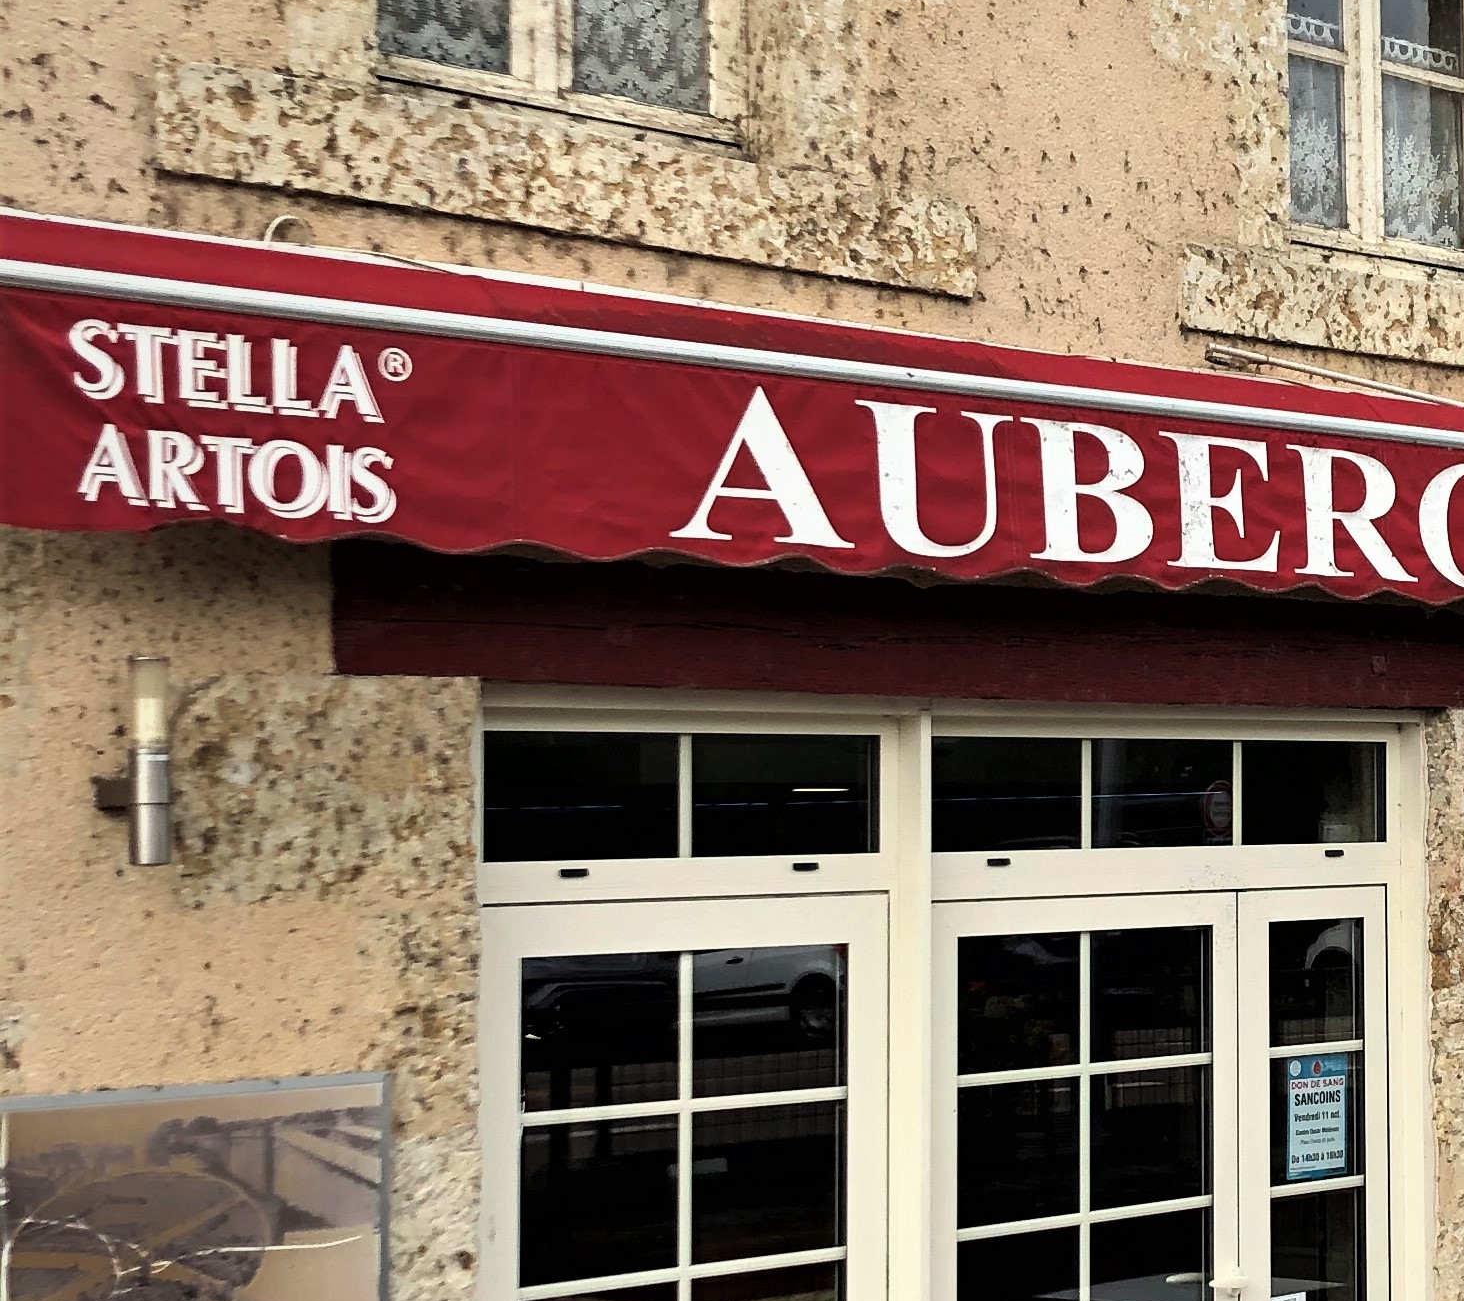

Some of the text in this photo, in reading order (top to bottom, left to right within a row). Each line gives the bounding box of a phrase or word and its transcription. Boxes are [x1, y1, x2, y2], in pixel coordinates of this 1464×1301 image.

[77, 423, 397, 524] ARTOIS
[1291, 1077, 1344, 1090] DON DE SANG
[1294, 1090, 1341, 1107] SANCOINS
[1294, 1112, 1320, 1122] Vendredi
[1321, 1110, 1329, 1119] 11
